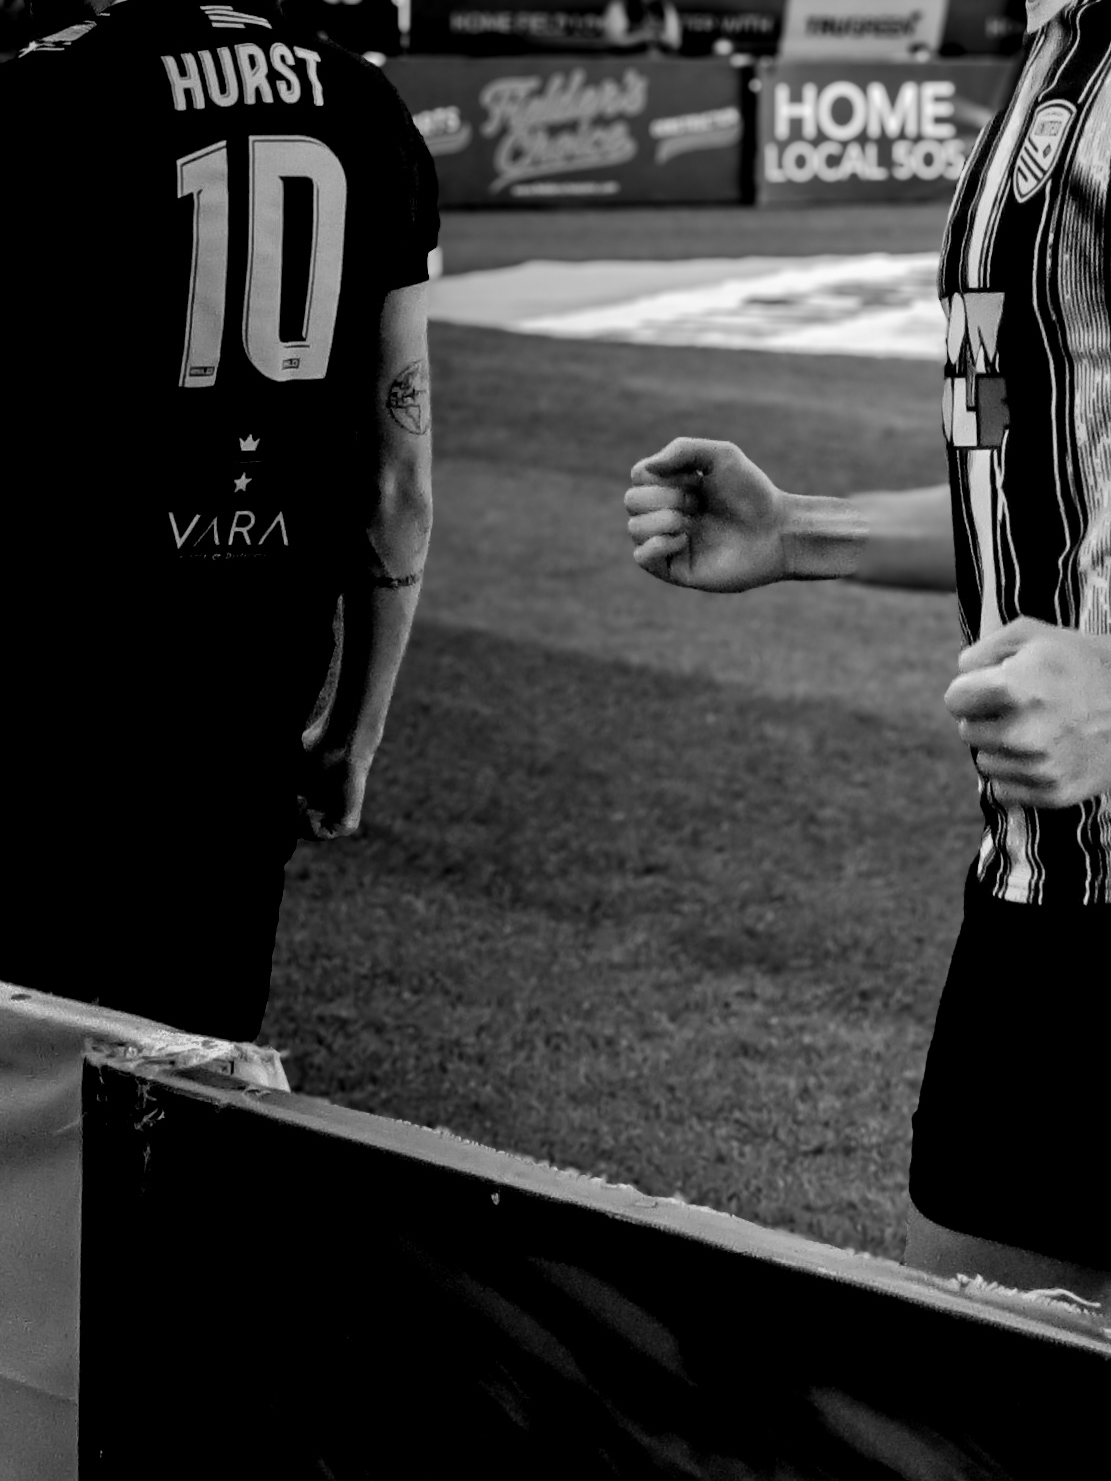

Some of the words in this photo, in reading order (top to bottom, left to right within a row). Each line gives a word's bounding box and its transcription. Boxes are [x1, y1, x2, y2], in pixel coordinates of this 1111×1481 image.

[161, 43, 325, 111] HURST
[774, 80, 957, 141] HOME
[764, 140, 889, 183] LOCAL
[176, 135, 347, 387] 10
